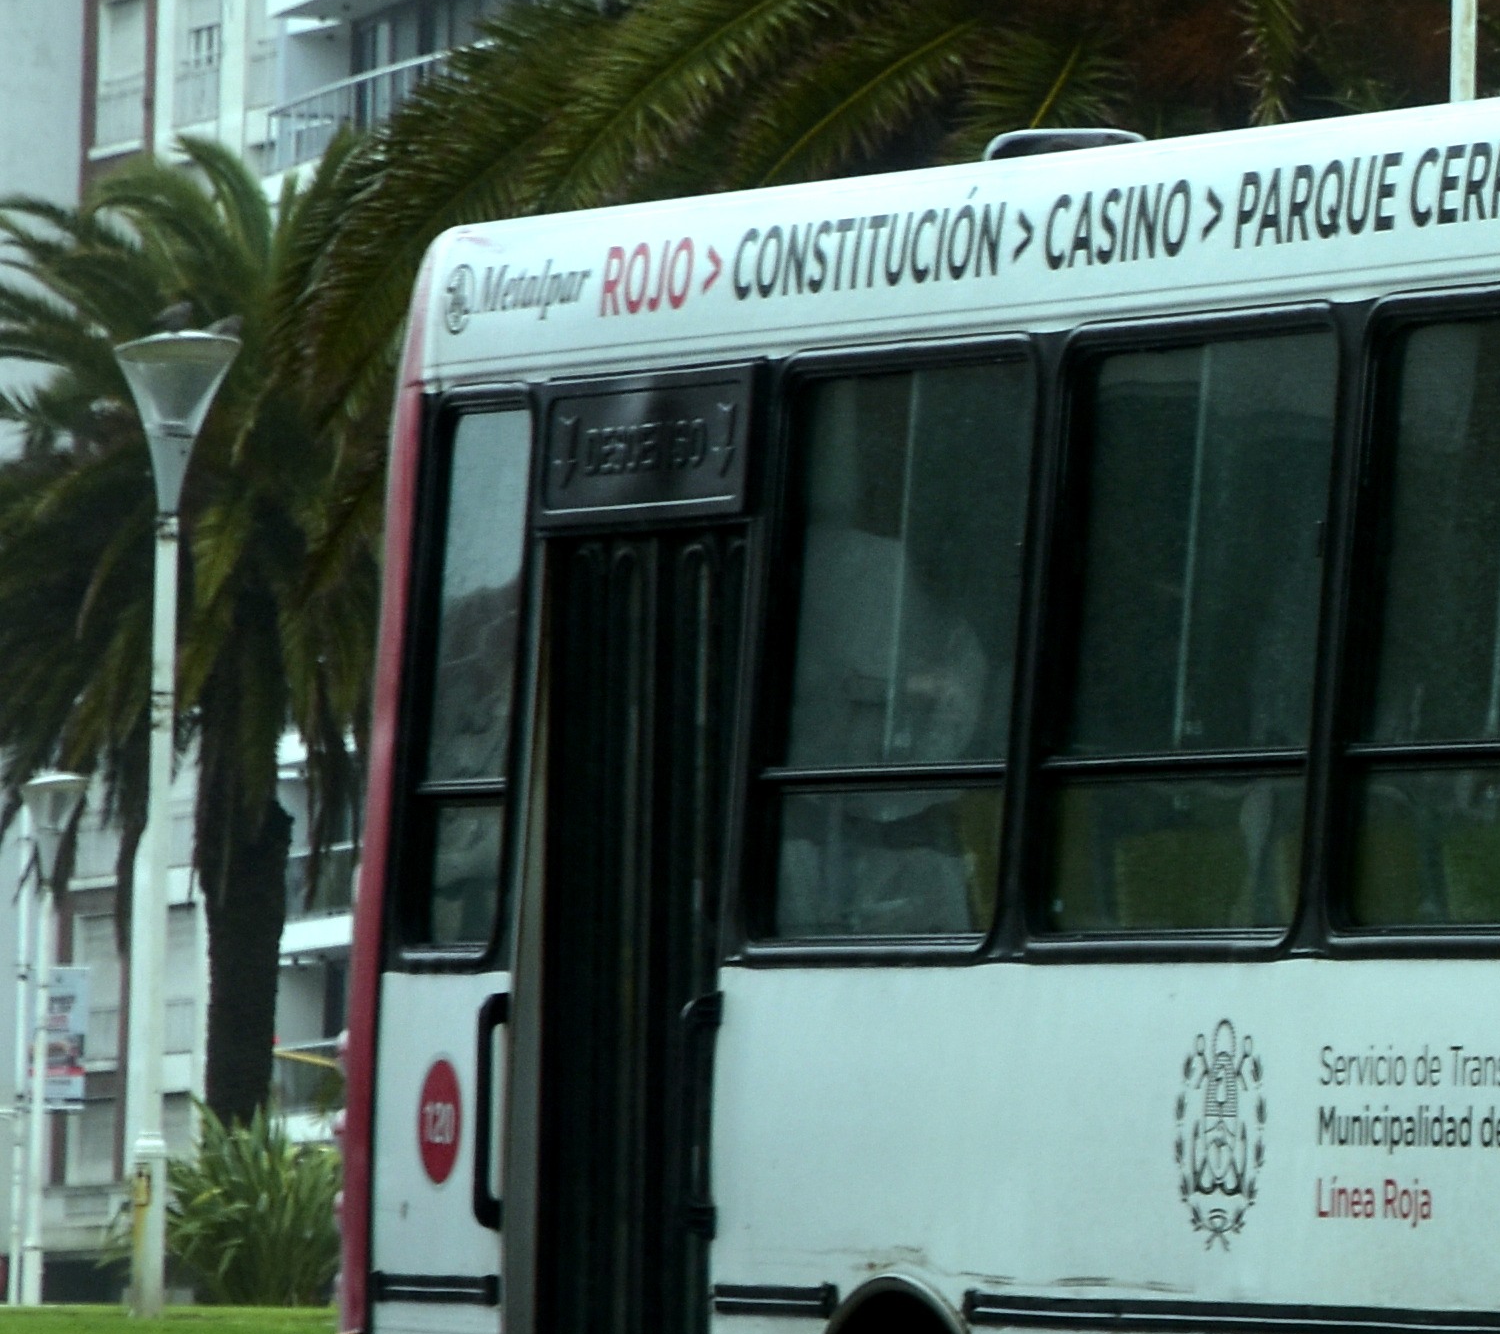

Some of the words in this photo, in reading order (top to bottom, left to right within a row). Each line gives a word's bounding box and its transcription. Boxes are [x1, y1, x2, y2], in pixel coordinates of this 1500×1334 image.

[598, 236, 695, 318] ROJO
[734, 186, 1008, 302] CONSTITUCIÓN
[1044, 178, 1192, 272] CASINO
[1234, 151, 1405, 249] PARQUE
[1319, 1044, 1407, 1087] Servicio
[1414, 1043, 1442, 1087] de
[421, 1102, 455, 1145] 120
[1318, 1104, 1473, 1156] Municipalidad
[1316, 1175, 1375, 1219] Línea
[1383, 1177, 1433, 1228] Roja
